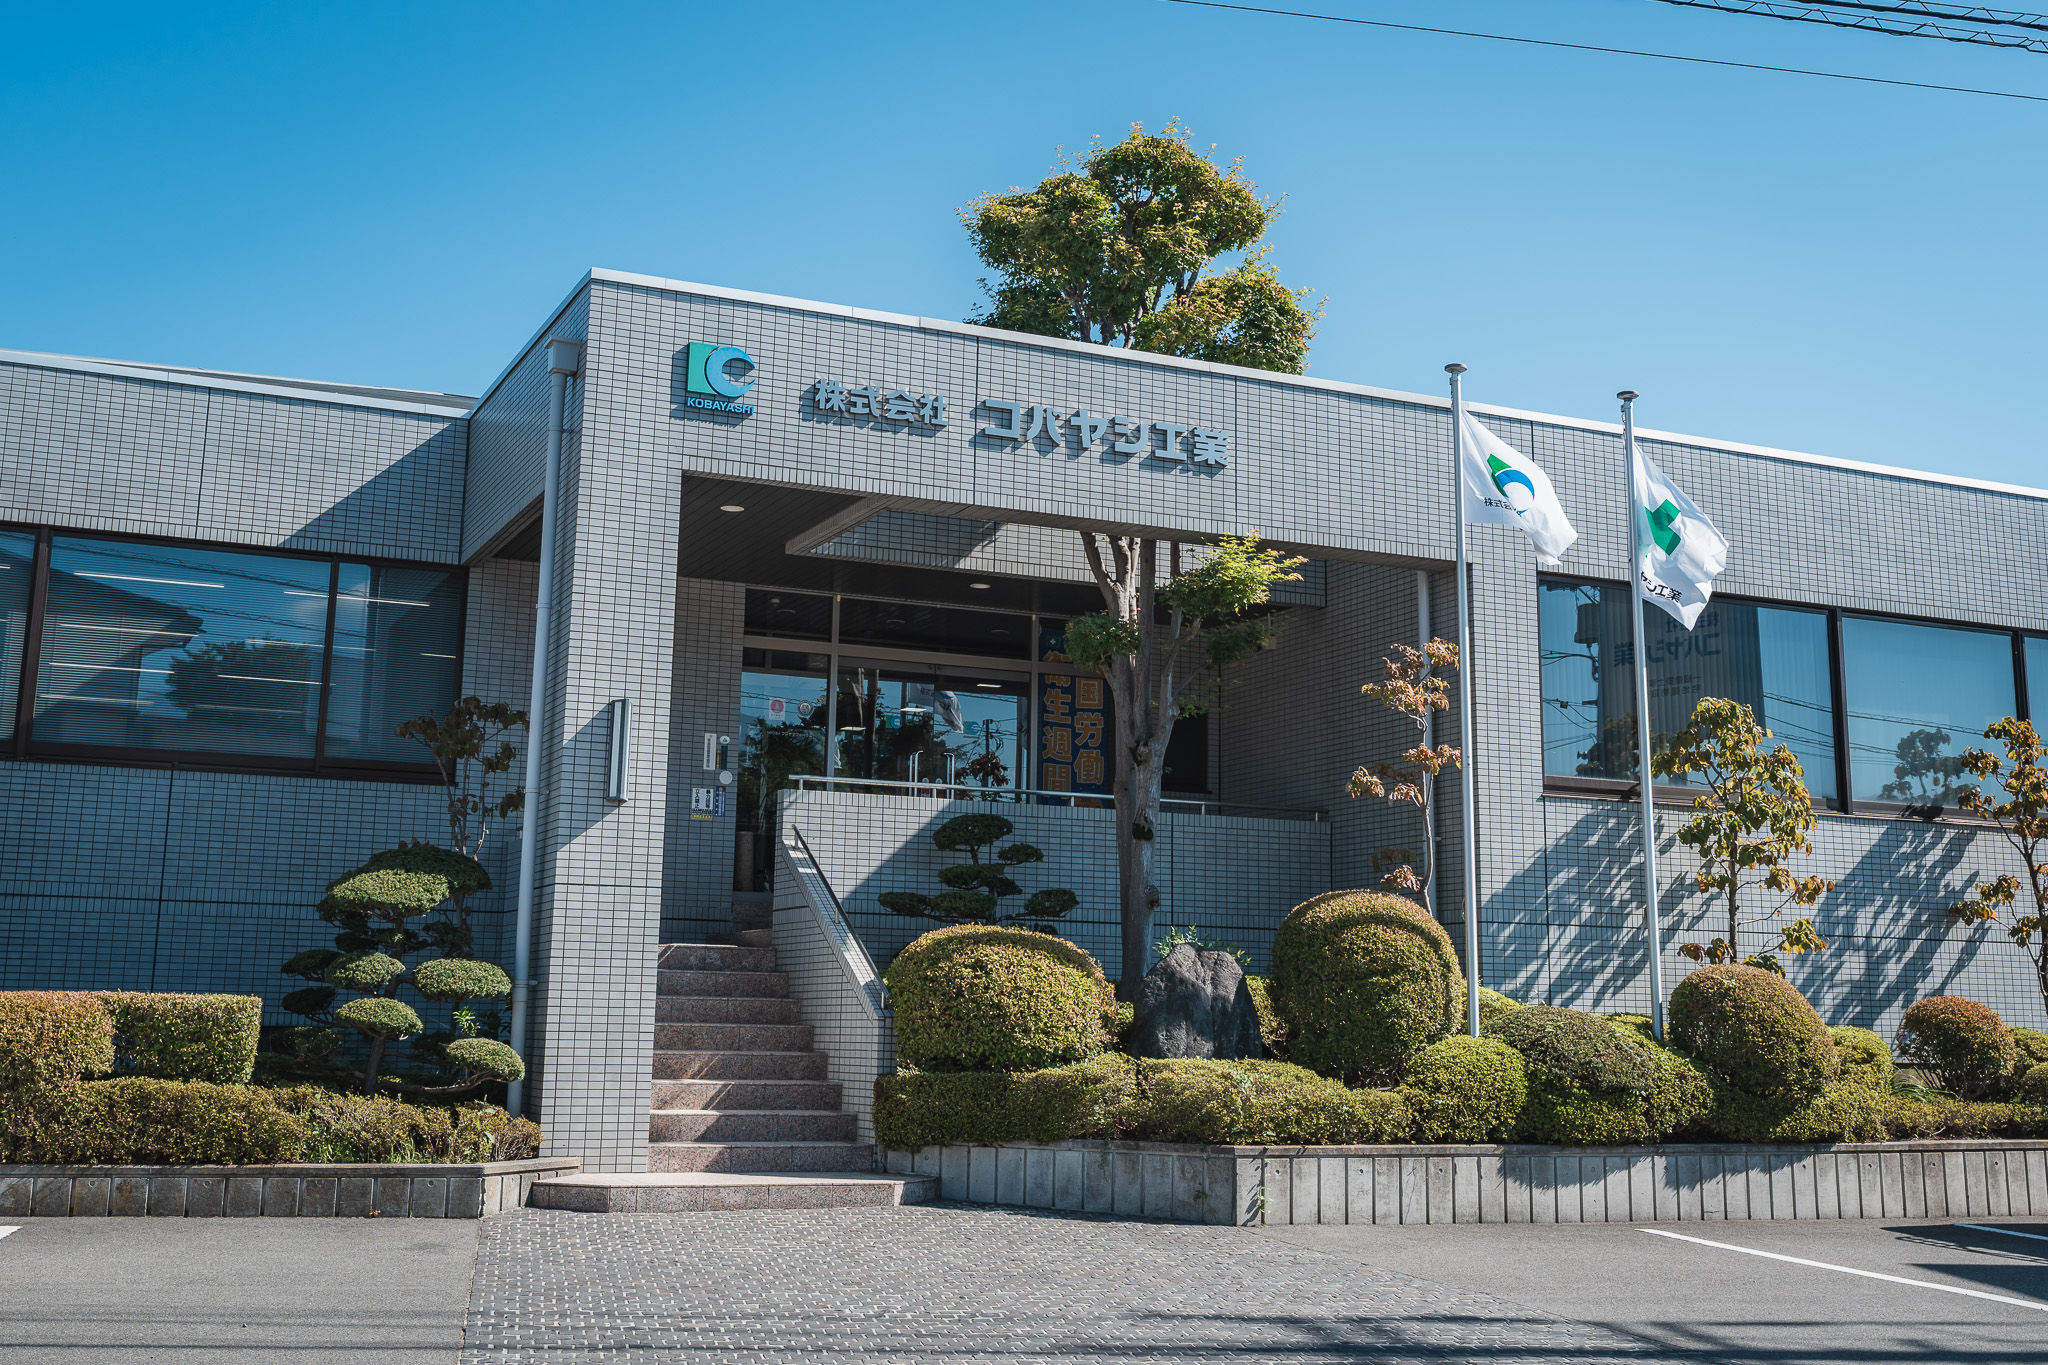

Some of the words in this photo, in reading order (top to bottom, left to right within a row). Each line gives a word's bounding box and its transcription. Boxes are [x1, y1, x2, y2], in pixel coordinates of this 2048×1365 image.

[686, 397, 754, 415] KOBAYASHI
[815, 377, 948, 427] 株式会社
[983, 398, 1230, 467] コバヤシ工業
